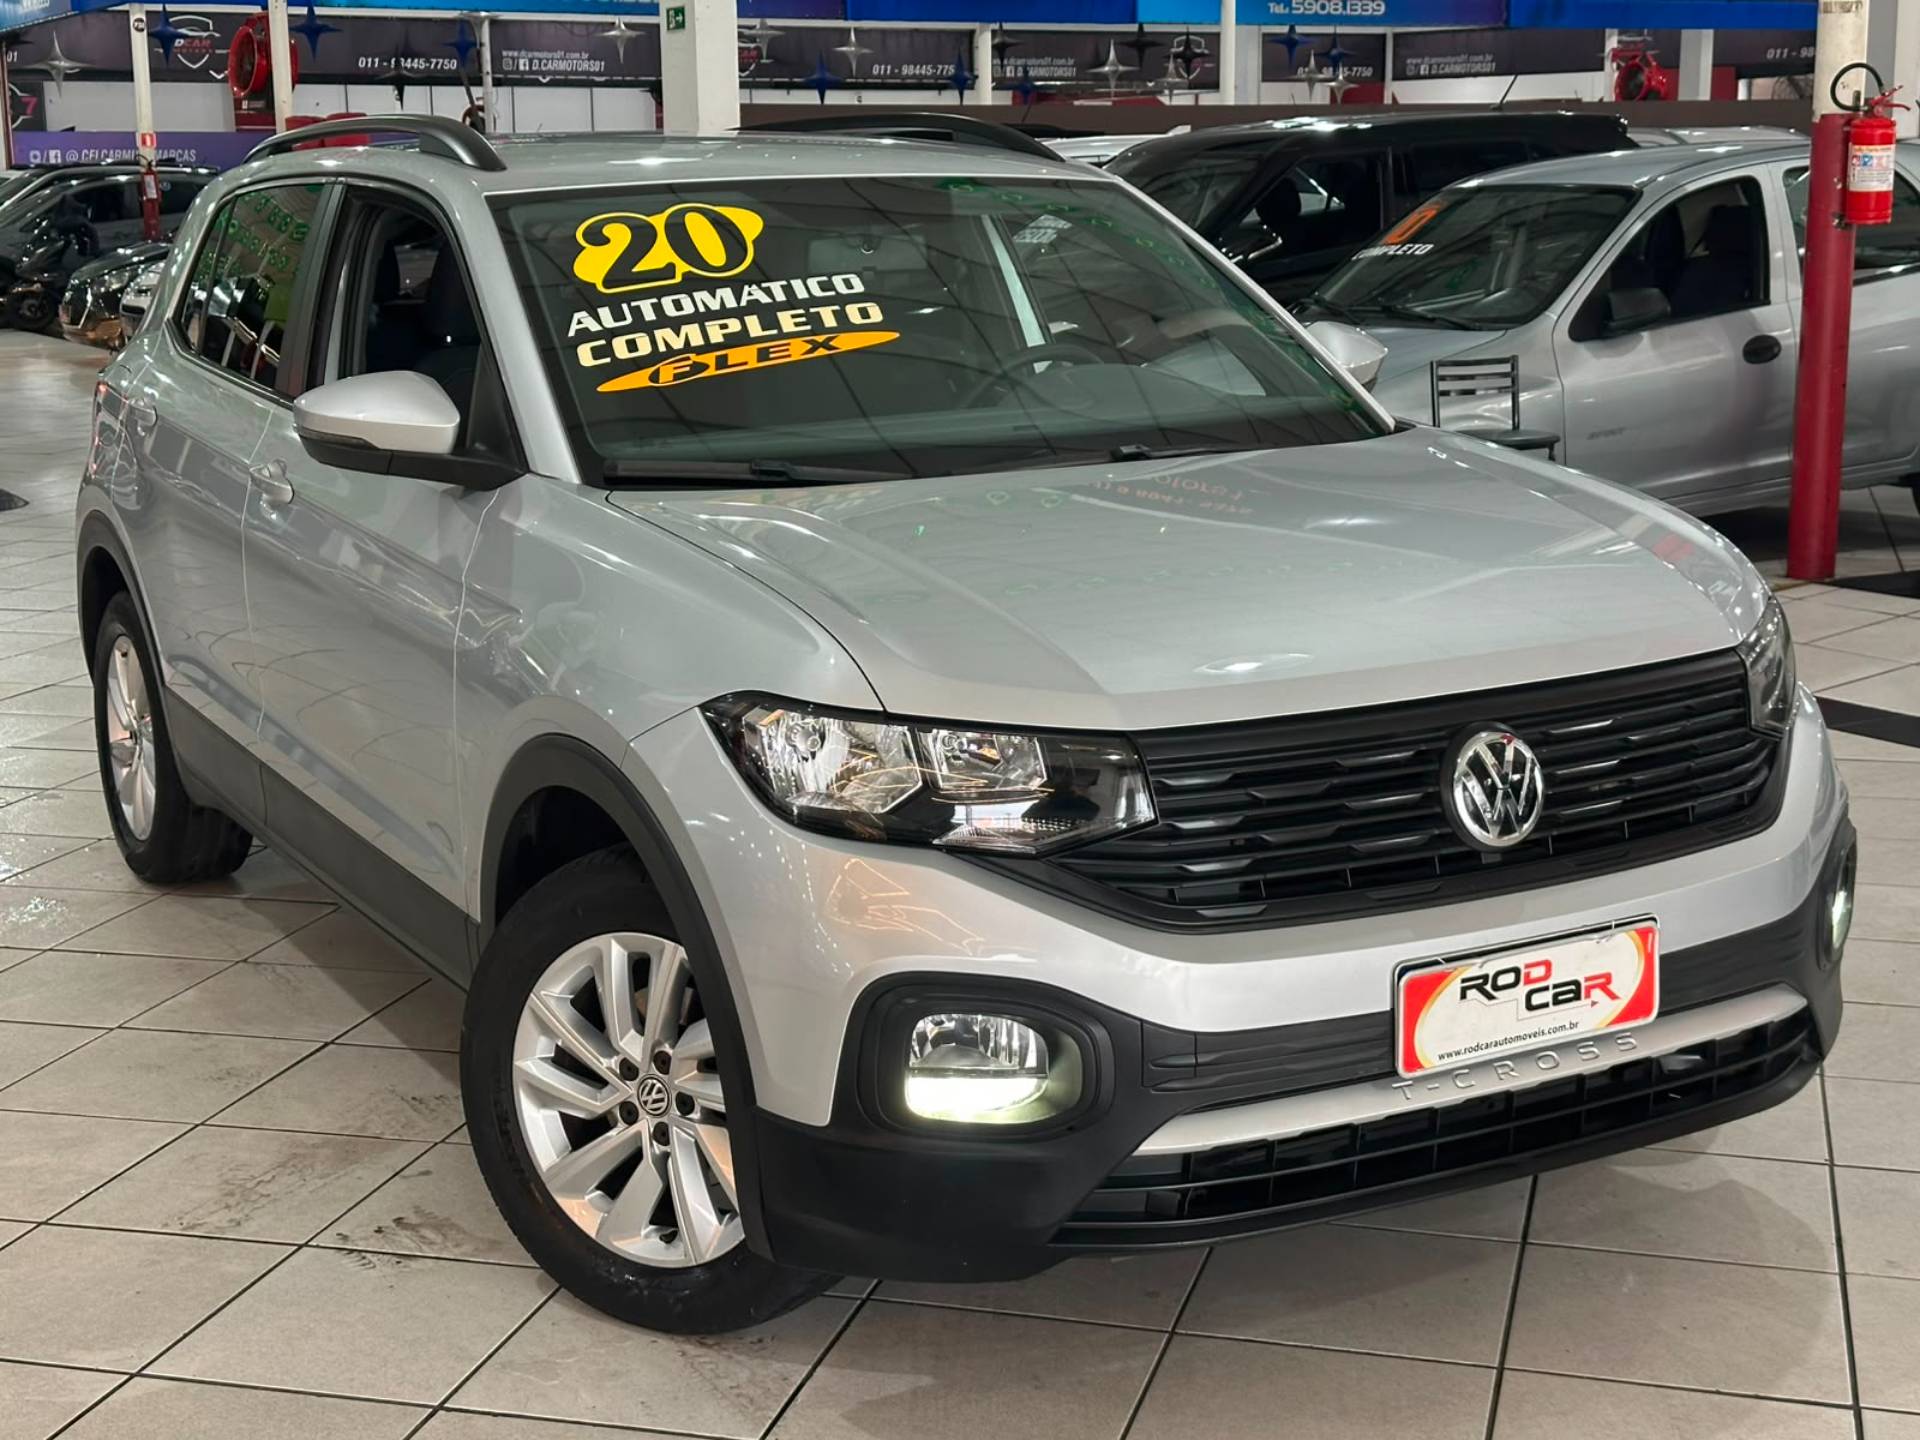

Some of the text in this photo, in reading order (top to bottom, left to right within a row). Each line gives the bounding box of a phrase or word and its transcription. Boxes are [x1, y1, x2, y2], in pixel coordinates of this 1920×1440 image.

[358, 57, 379, 68] 011
[872, 64, 890, 75] 011
[1766, 48, 1788, 59] 011
[576, 203, 754, 293] 20
[567, 273, 865, 337] AUTOMÁTICO
[576, 302, 884, 367] COMPLETO
[650, 335, 842, 385] FLEX
[1437, 1020, 1579, 1061] www.rodcarautomoveis.com.br
[1391, 1032, 1638, 1100] T-CROSS
